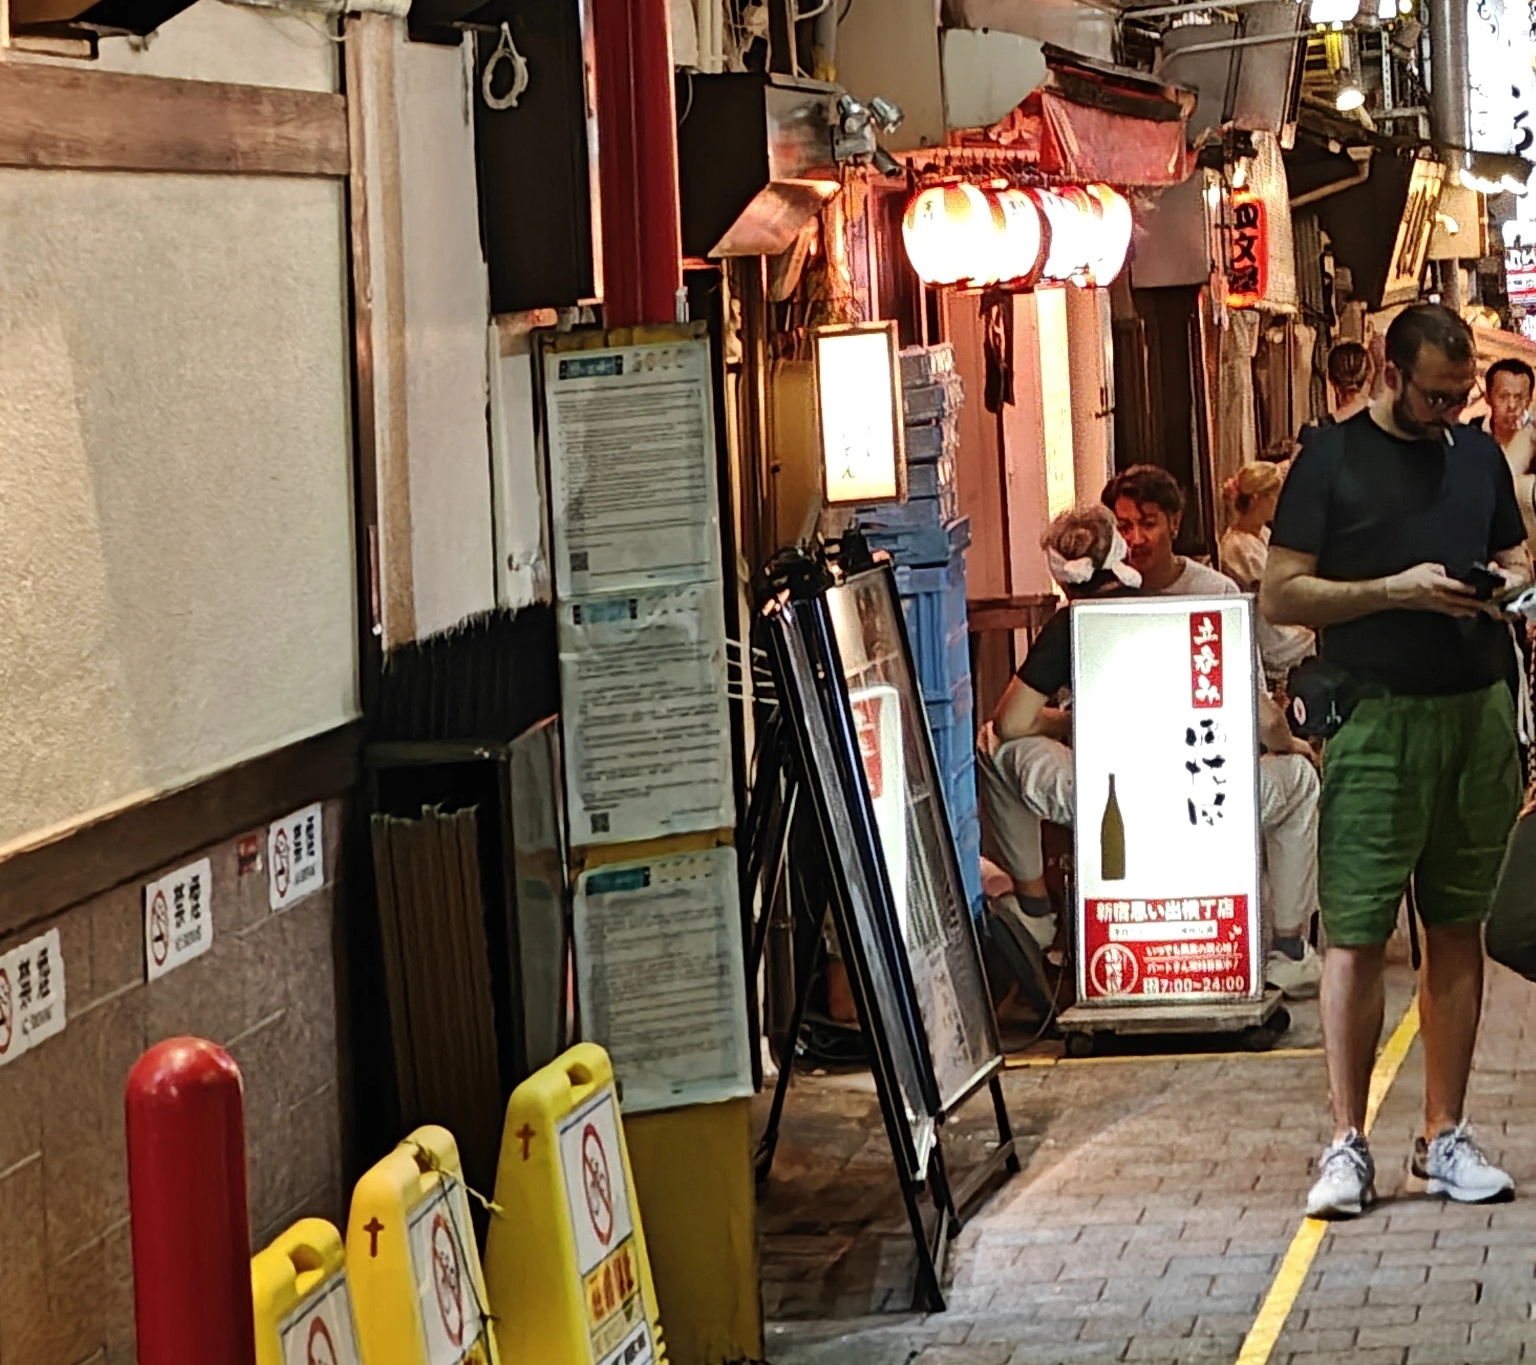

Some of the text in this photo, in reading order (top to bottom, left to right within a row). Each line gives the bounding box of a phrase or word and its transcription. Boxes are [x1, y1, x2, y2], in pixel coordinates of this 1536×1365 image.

[1096, 897, 1235, 923] 新宿思い出横丁店
